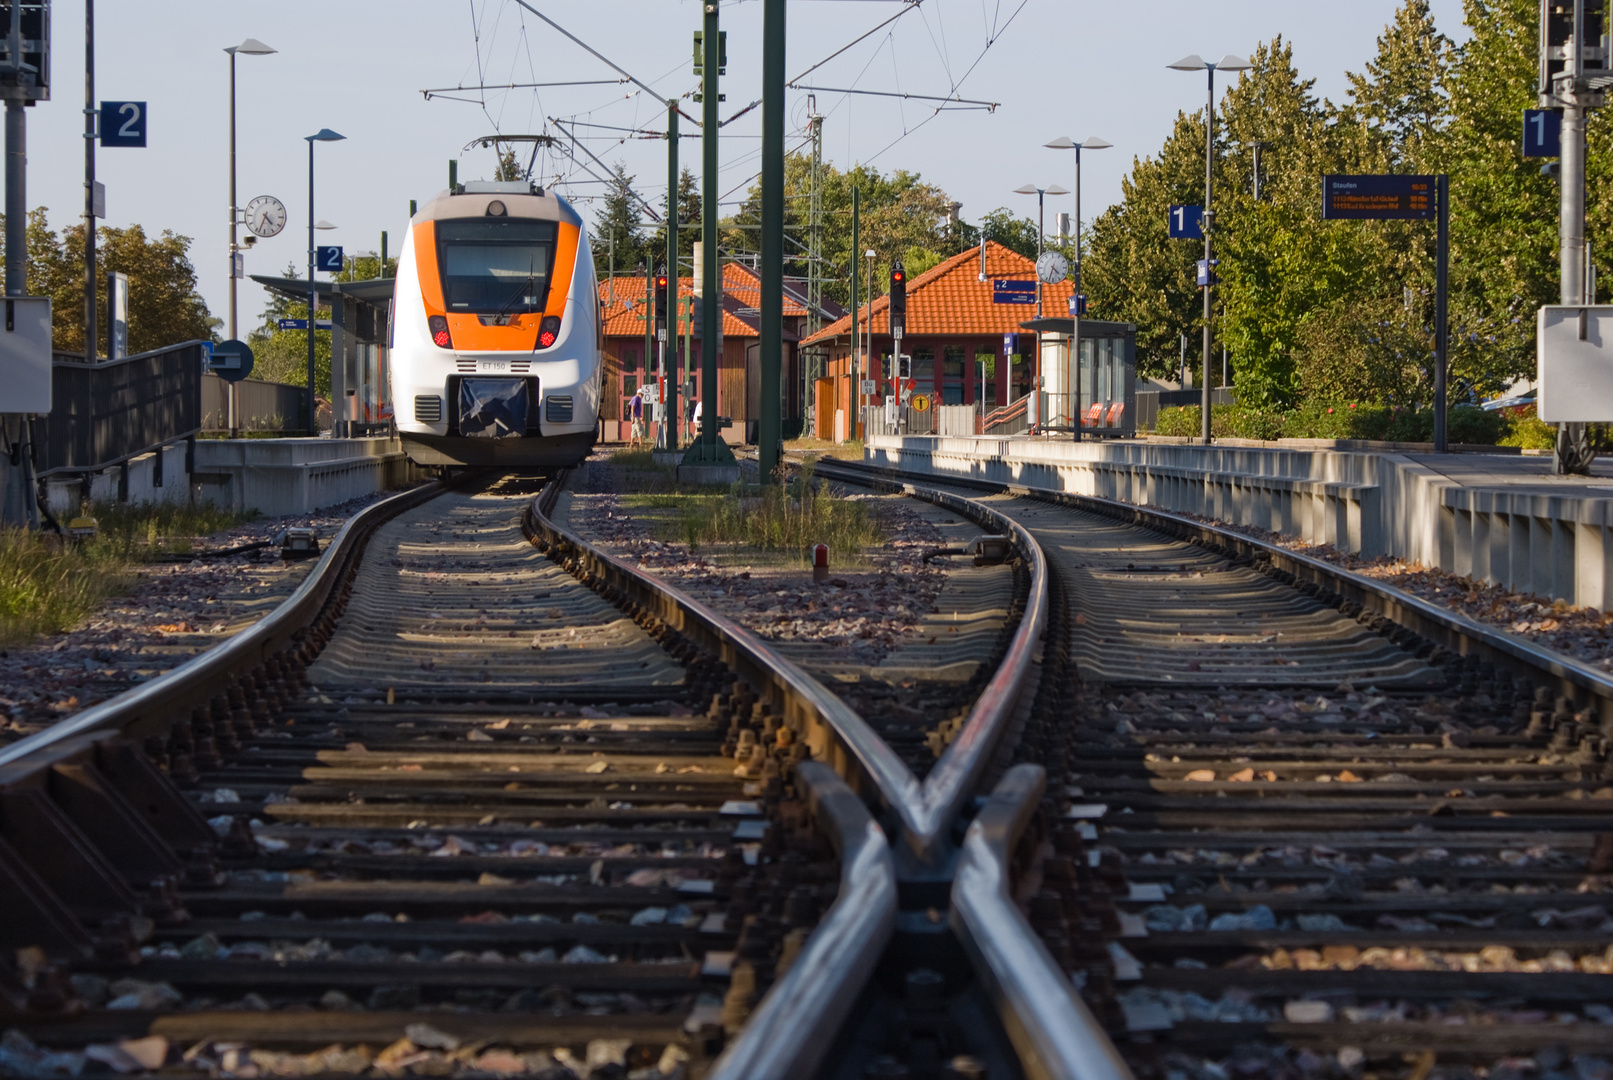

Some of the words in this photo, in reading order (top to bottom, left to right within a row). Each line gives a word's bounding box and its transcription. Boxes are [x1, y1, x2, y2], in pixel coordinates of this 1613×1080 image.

[118, 103, 140, 137] 2
[1530, 111, 1544, 146] 1
[1173, 206, 1184, 231] 1
[327, 247, 340, 266] 2
[896, 260, 900, 269] 6
[660, 266, 665, 275] 6
[1002, 280, 1007, 288] 2
[482, 362, 492, 370] ET
[494, 362, 506, 370] 150
[645, 386, 650, 394] 5
